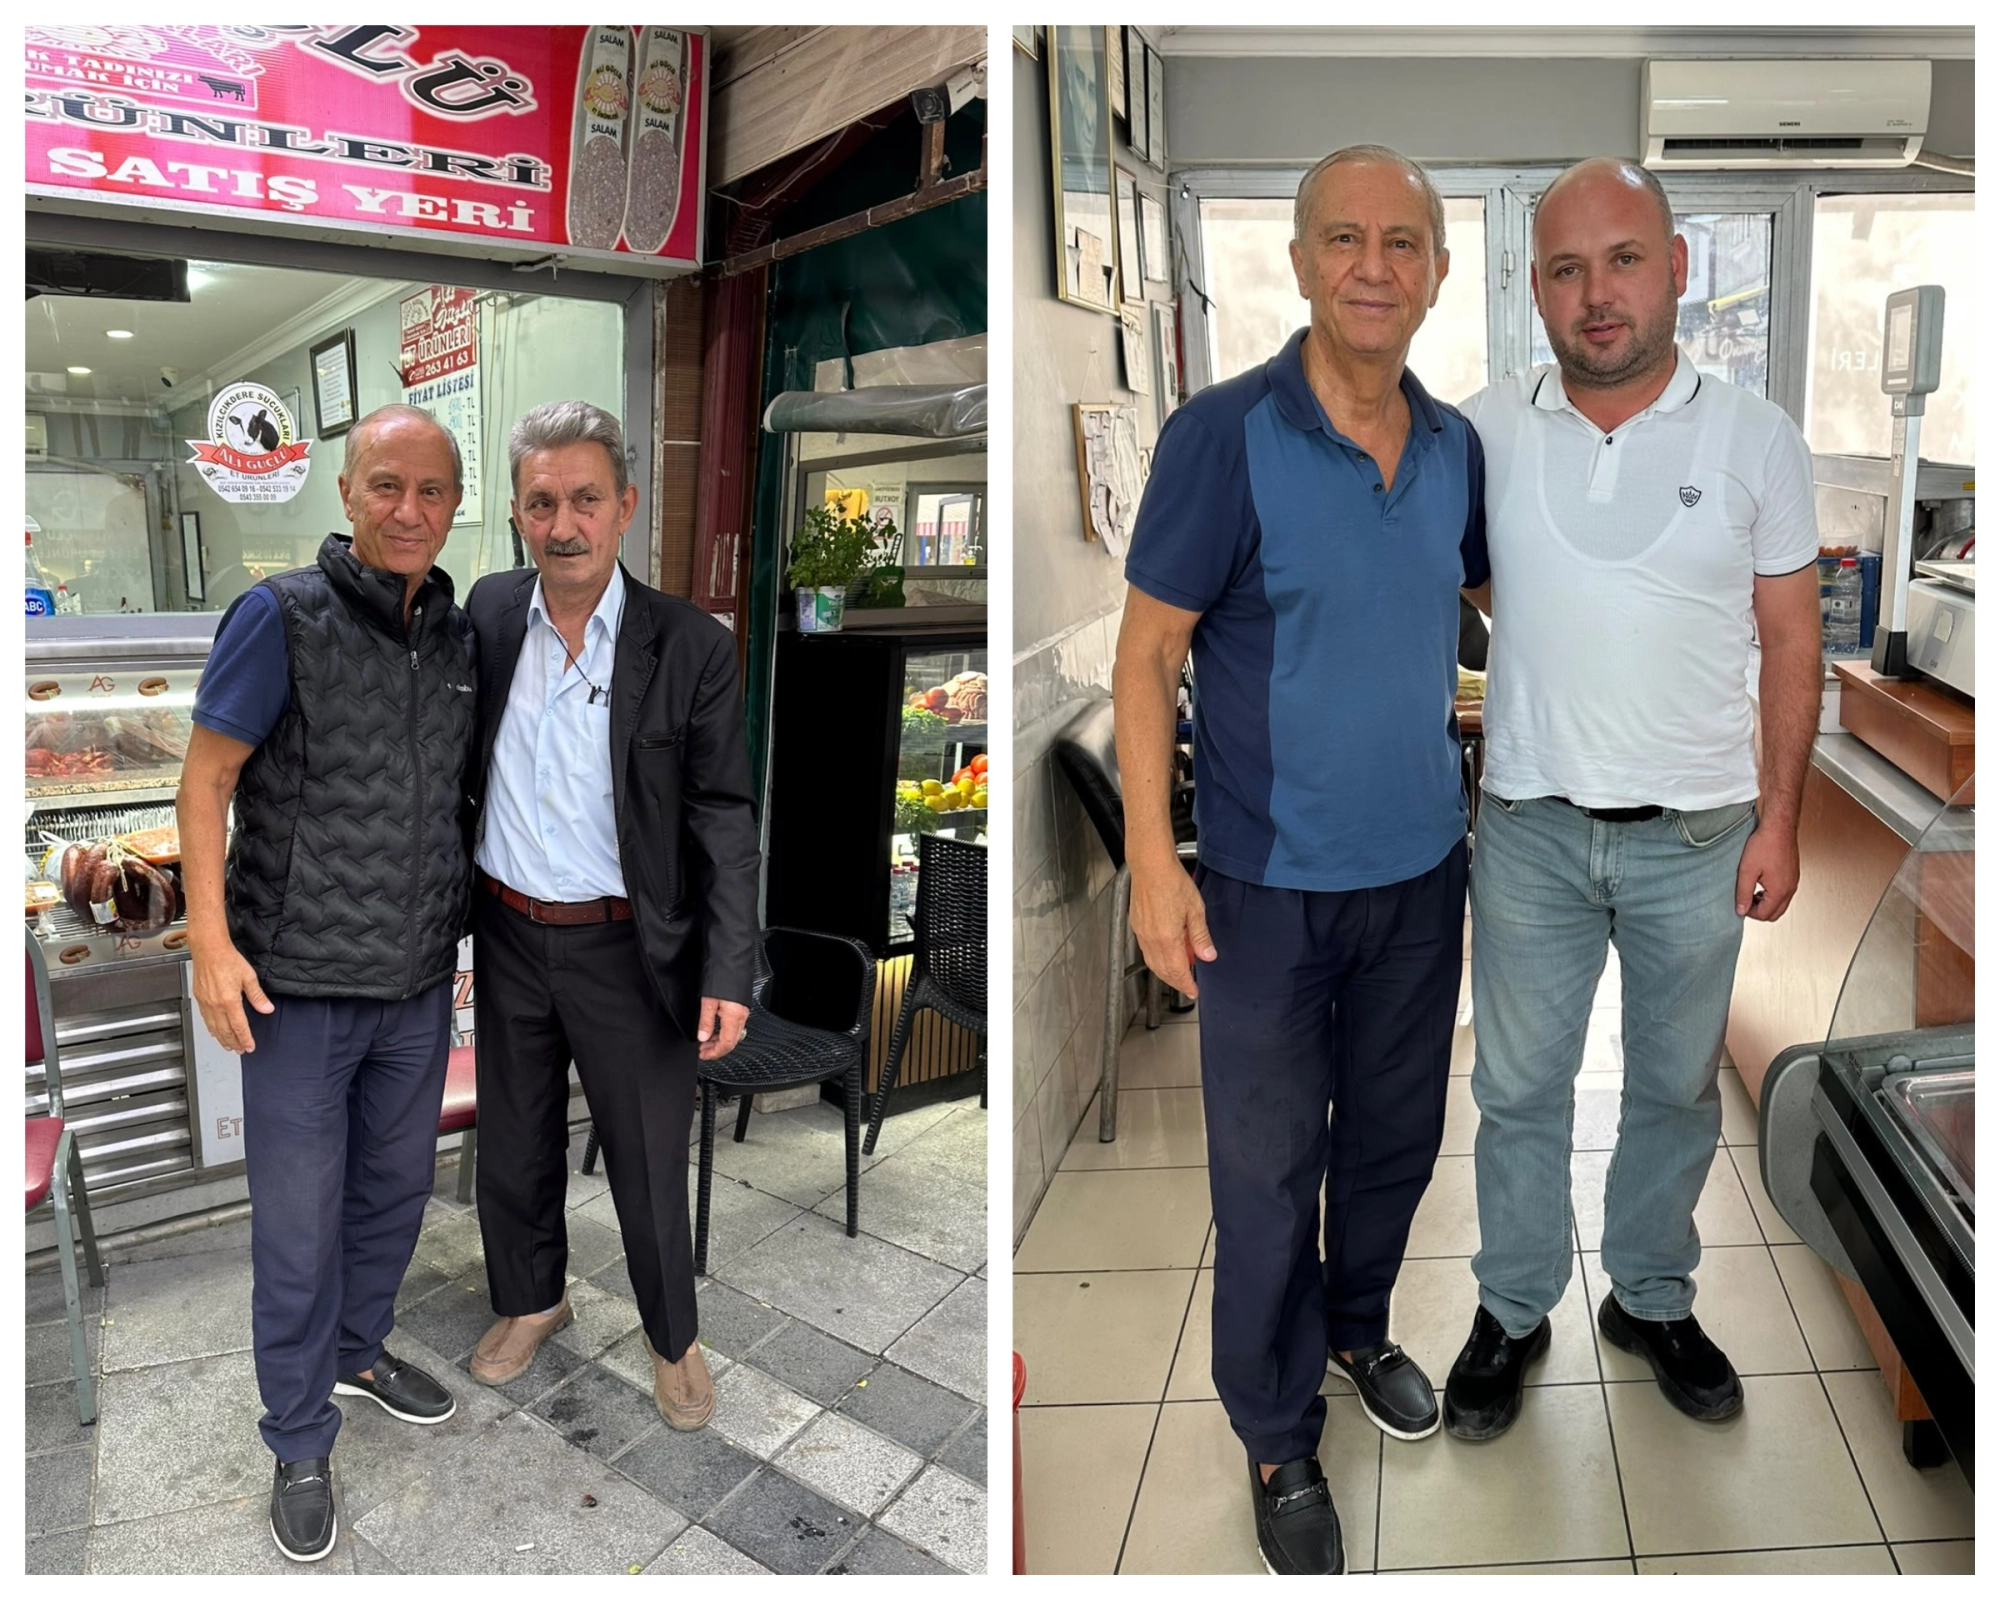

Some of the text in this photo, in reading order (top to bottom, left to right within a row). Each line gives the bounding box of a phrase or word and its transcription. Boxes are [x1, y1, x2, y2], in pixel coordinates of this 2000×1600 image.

[599, 34, 625, 48] SALAM
[654, 30, 679, 45] SALAM
[64, 54, 194, 84] TADINIZI
[123, 74, 180, 93] İÇİN
[591, 124, 617, 138] SALAM
[645, 118, 670, 132] SALAM
[47, 147, 535, 232] SATIŞ YERİ
[418, 317, 471, 363] ÜRÜNLERİ
[425, 361, 442, 377] 263
[443, 356, 454, 370] 41
[456, 350, 469, 365] 63
[408, 384, 435, 405] FİYAT
[437, 371, 475, 398] LİSTESİ
[216, 391, 290, 440] KIZILCIKDERE SUCUKLARI
[220, 447, 288, 470] ALİ GÜÇLÜ
[230, 470, 239, 478] ET
[218, 485, 231, 493] 0542
[25, 601, 43, 612] ABC
